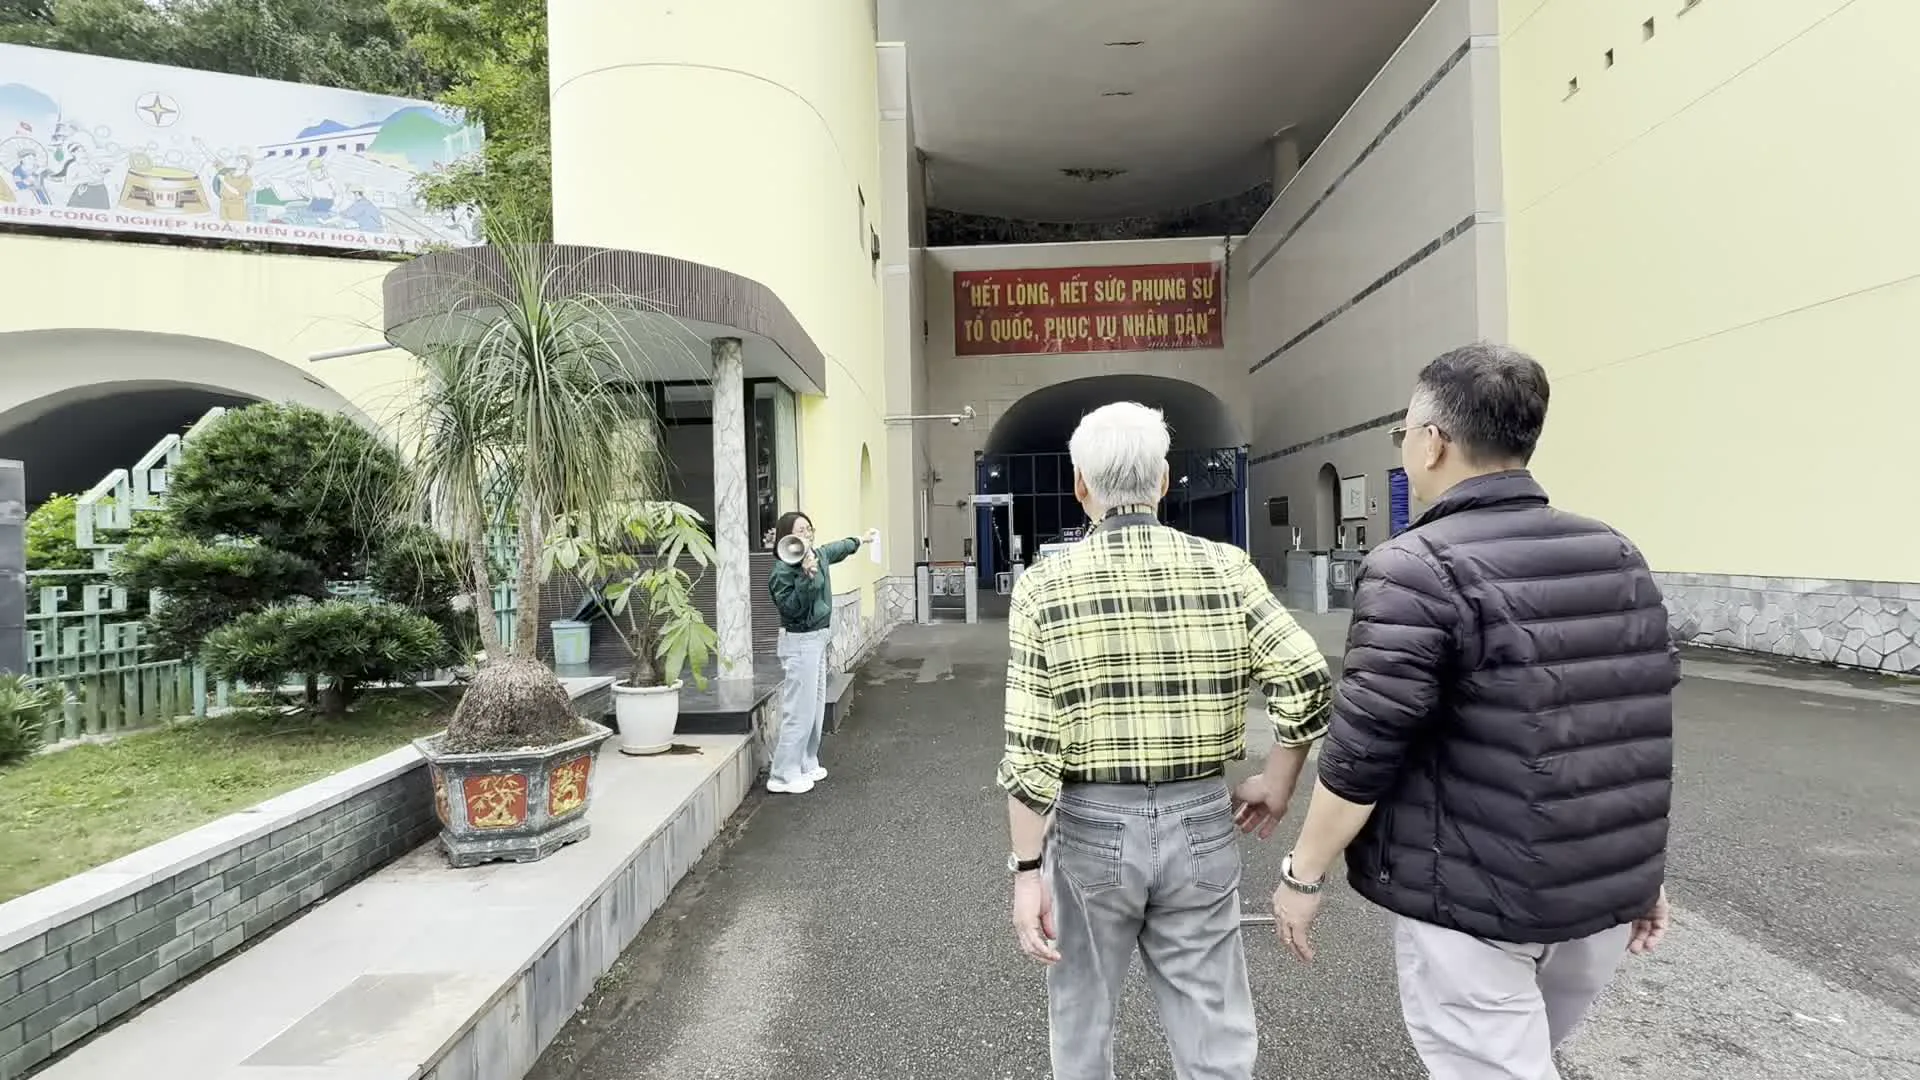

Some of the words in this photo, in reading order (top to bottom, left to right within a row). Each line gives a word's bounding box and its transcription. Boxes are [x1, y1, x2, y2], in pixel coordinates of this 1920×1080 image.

[1007, 277, 1054, 307] LÒNG,
[1060, 273, 1088, 304] HẾT
[1094, 273, 1126, 303] SỨC
[1132, 277, 1186, 306] PHỤNG
[964, 309, 984, 341] TỔ
[991, 311, 1039, 344] QUỐC,
[1044, 315, 1089, 344] PHỤC
[1096, 316, 1117, 343] VỤ
[1123, 308, 1169, 337] NHÂN
